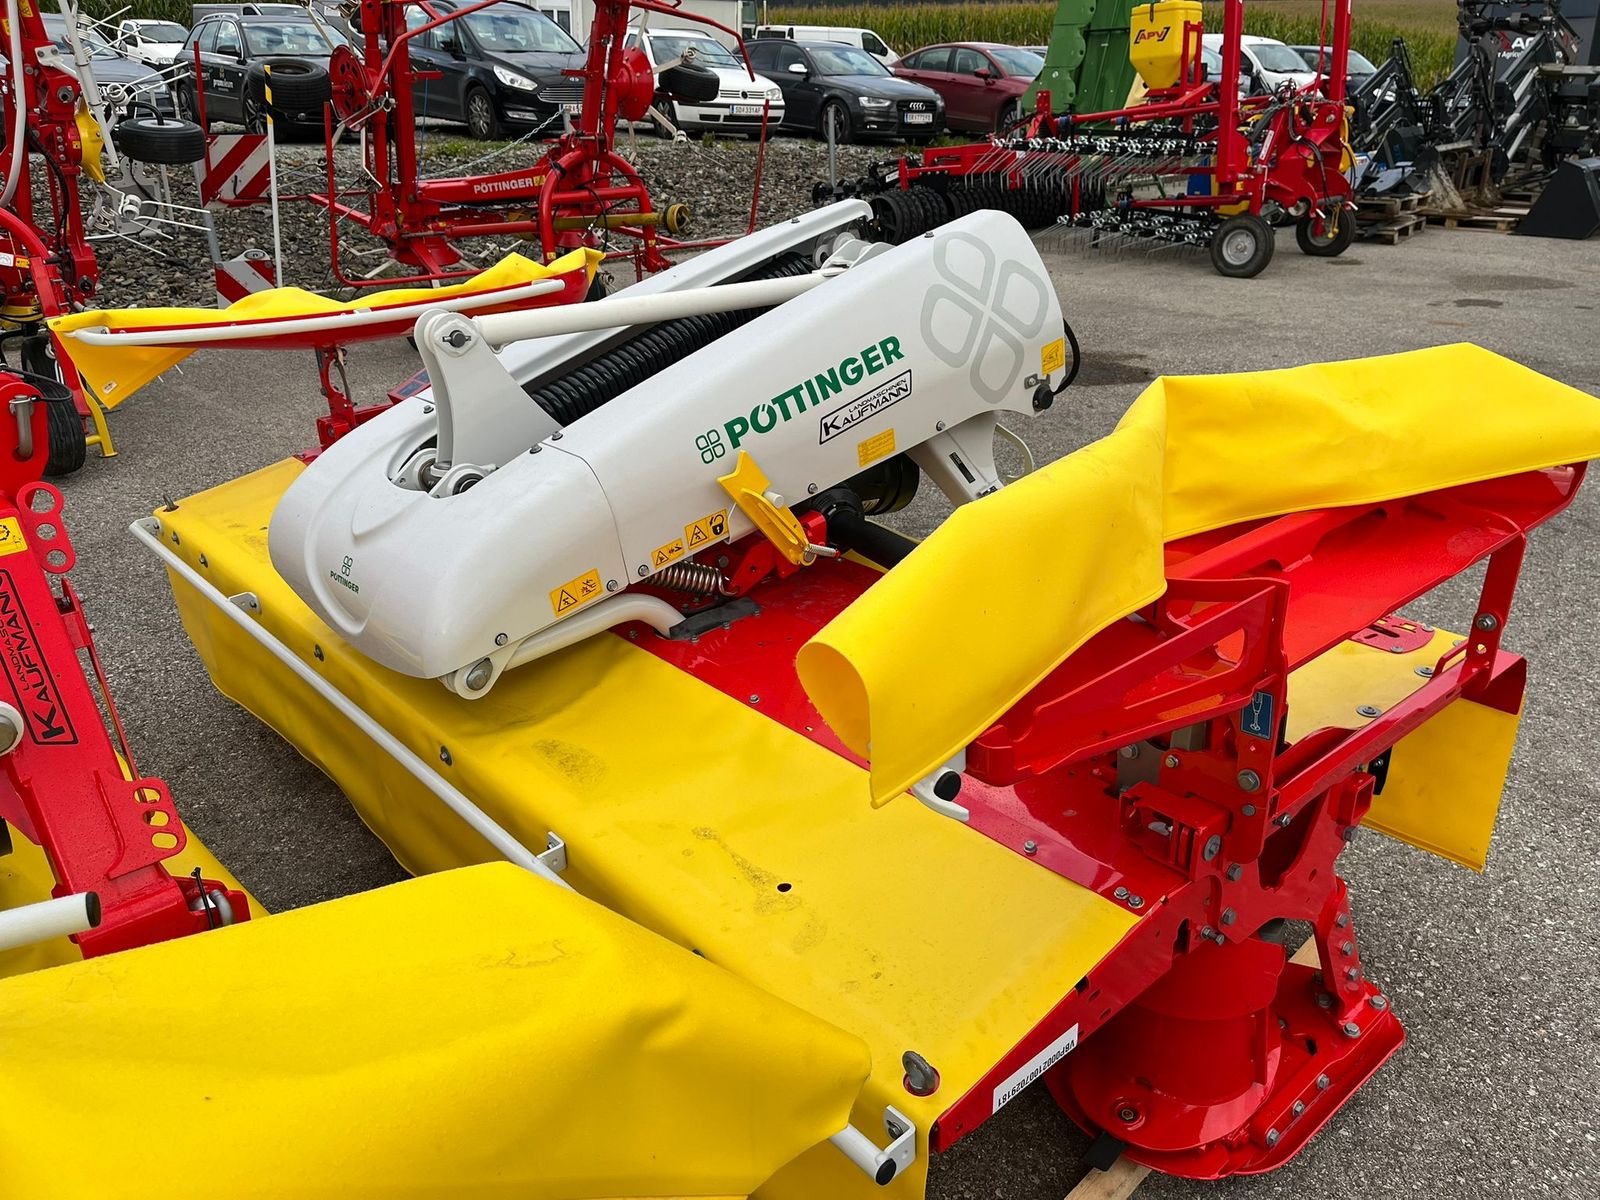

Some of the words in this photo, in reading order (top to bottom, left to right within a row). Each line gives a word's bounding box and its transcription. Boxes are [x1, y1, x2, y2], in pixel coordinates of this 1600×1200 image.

[473, 178, 534, 194] PÖTTINGER
[723, 335, 905, 450] PÖTTINGER
[823, 383, 909, 437] KAUFMANN
[848, 378, 907, 413] LANDMASCHINEN
[0, 617, 30, 691] LANDMASC
